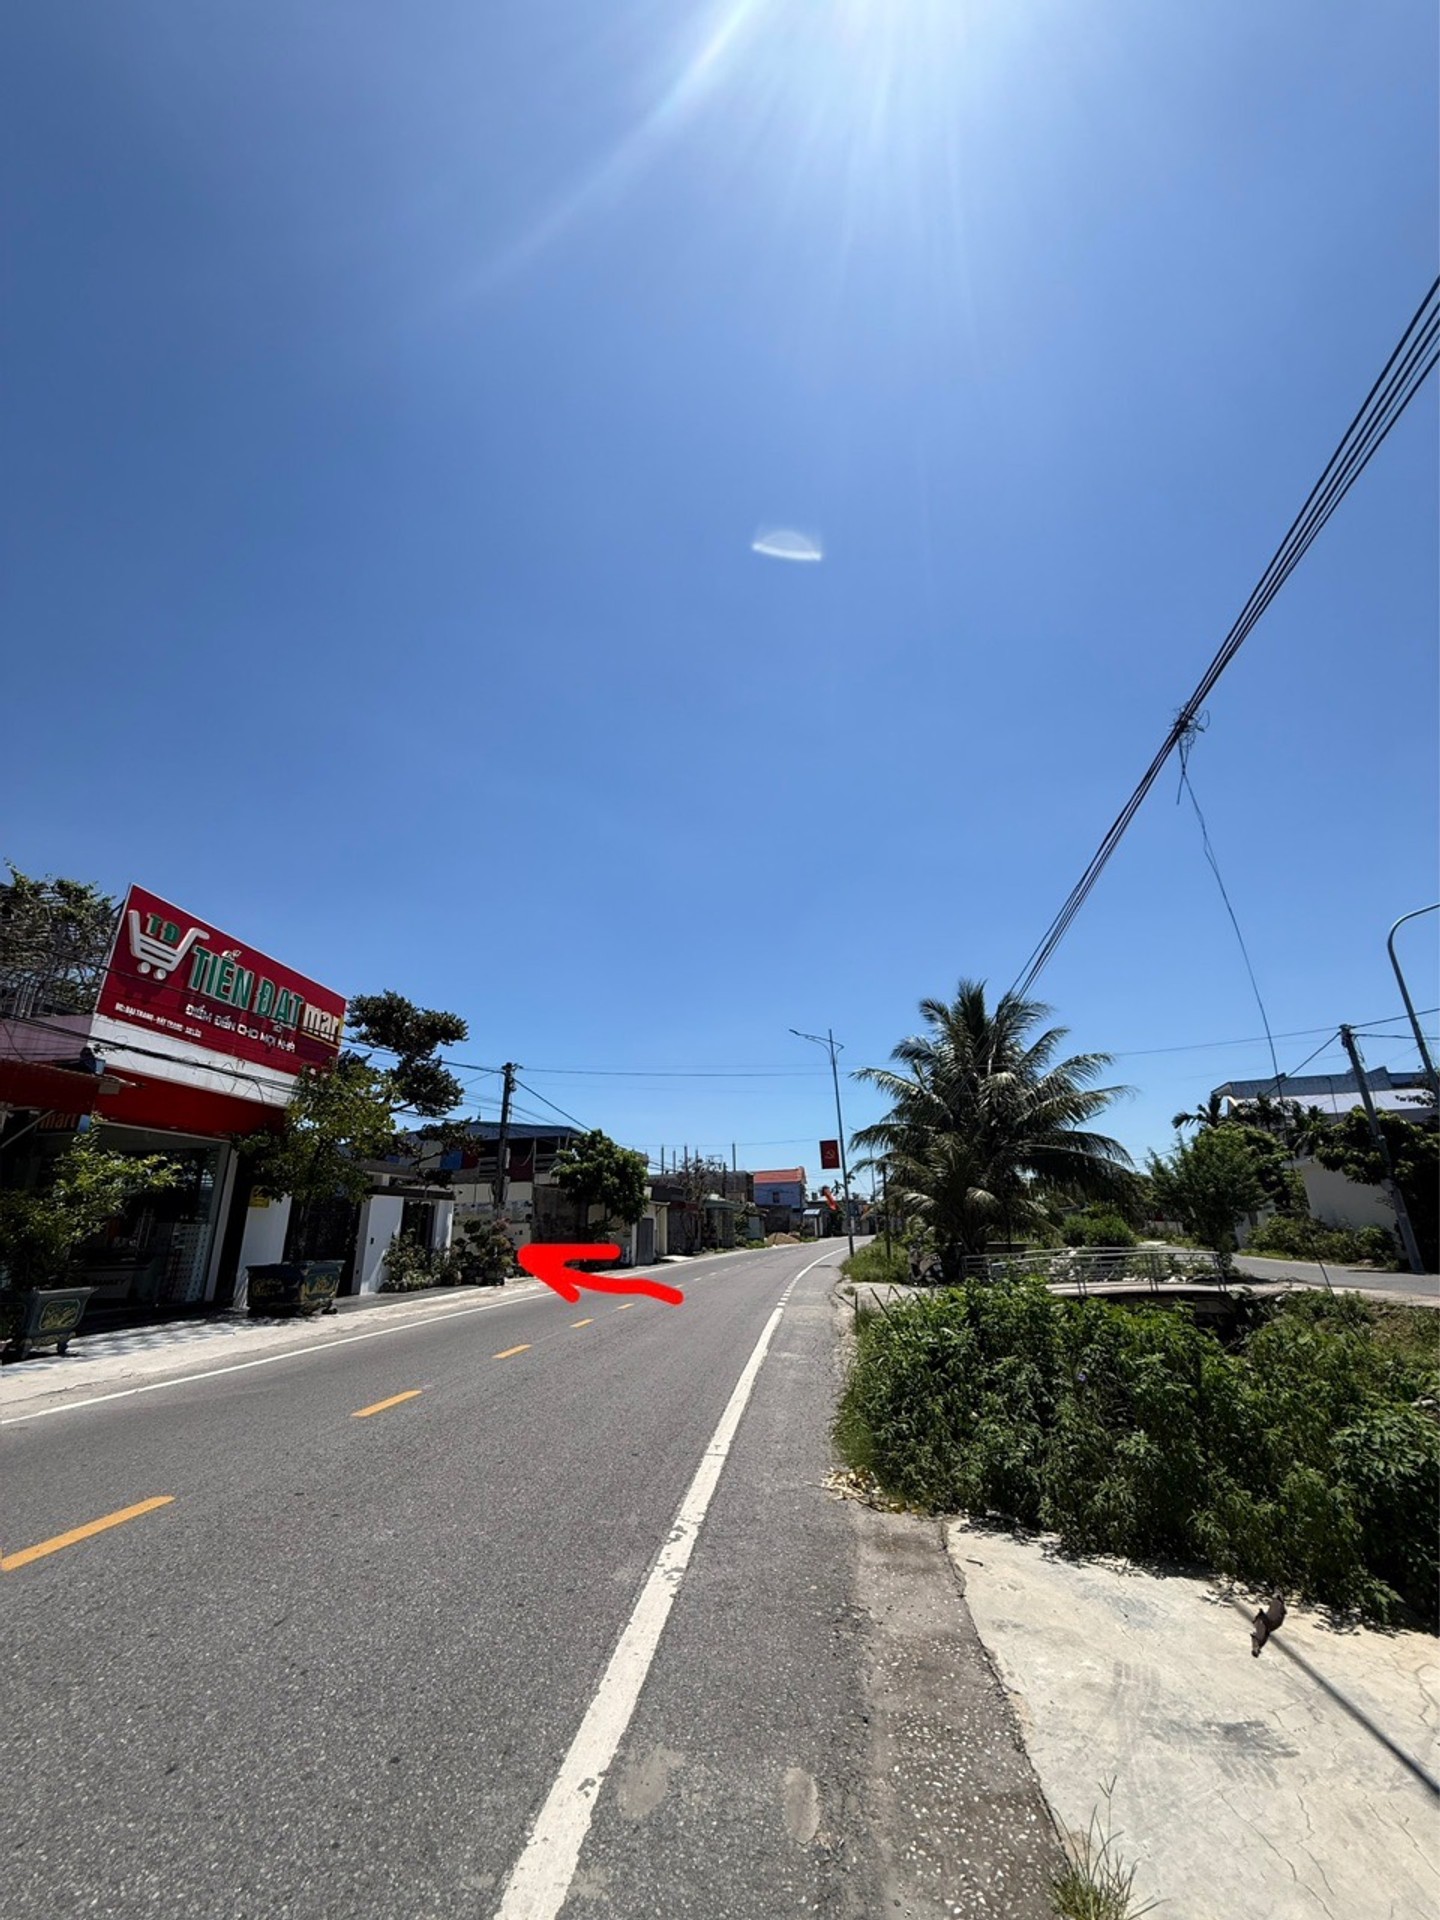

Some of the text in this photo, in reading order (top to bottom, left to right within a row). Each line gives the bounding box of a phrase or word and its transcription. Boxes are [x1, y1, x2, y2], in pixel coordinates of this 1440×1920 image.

[147, 912, 180, 945] TĐ
[255, 977, 304, 1032] ĐẠT
[237, 1023, 259, 1040] CHO
